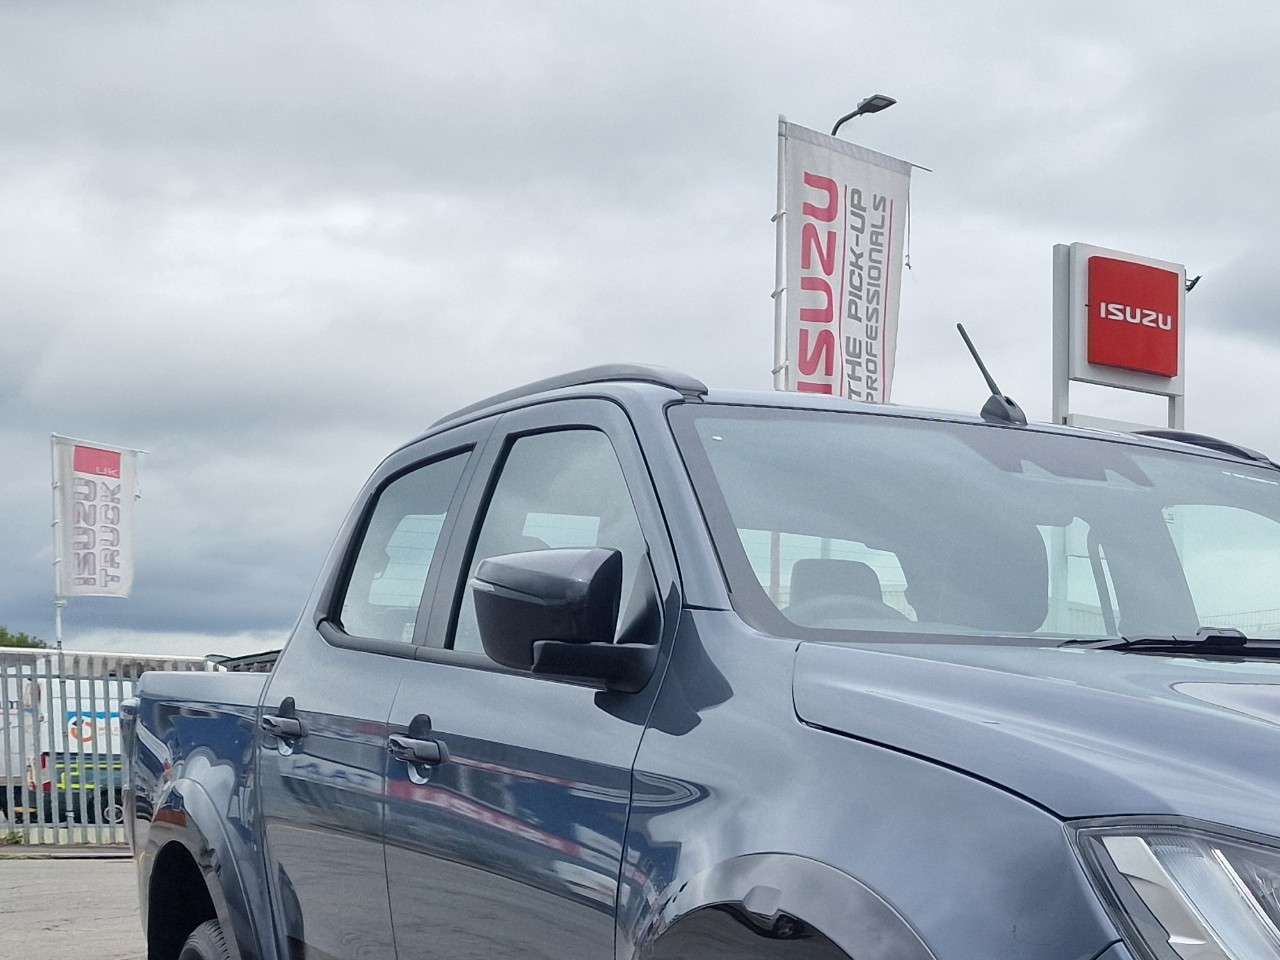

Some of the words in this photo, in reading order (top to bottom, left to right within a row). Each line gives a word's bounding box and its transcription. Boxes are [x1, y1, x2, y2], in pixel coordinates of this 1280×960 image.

[797, 171, 838, 394] ISUZU
[847, 187, 867, 323] PICK-UP
[866, 193, 887, 402] PROFESSIONALS
[847, 335, 862, 400] THE
[1100, 302, 1171, 330] ISUZU
[96, 465, 119, 478] UK
[72, 477, 97, 586] ISUZU
[100, 481, 121, 588] TRUCK
